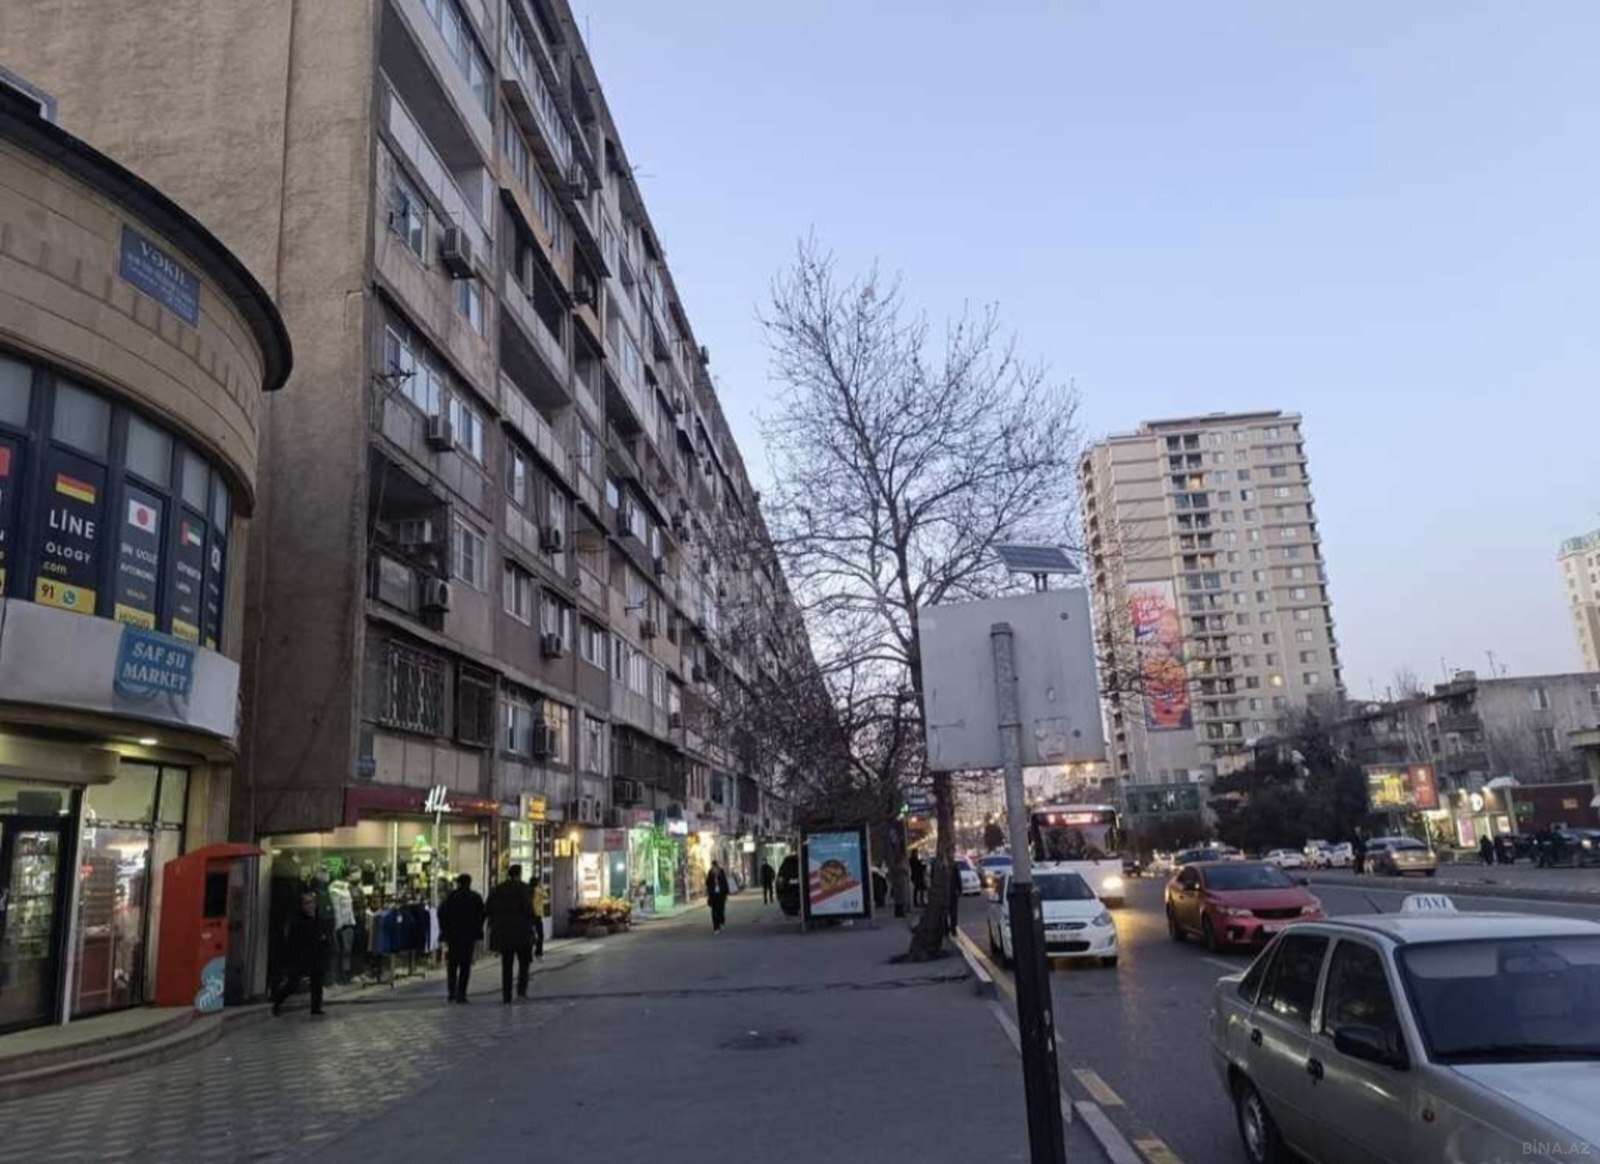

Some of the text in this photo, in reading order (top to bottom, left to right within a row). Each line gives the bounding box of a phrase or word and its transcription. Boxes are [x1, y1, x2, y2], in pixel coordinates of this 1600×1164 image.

[50, 509, 95, 540] LİNE
[45, 541, 92, 565] OLOGY
[41, 583, 54, 599] 91
[133, 641, 166, 662] SAF
[122, 661, 187, 692] MARKET
[1412, 896, 1447, 910] TAXI
